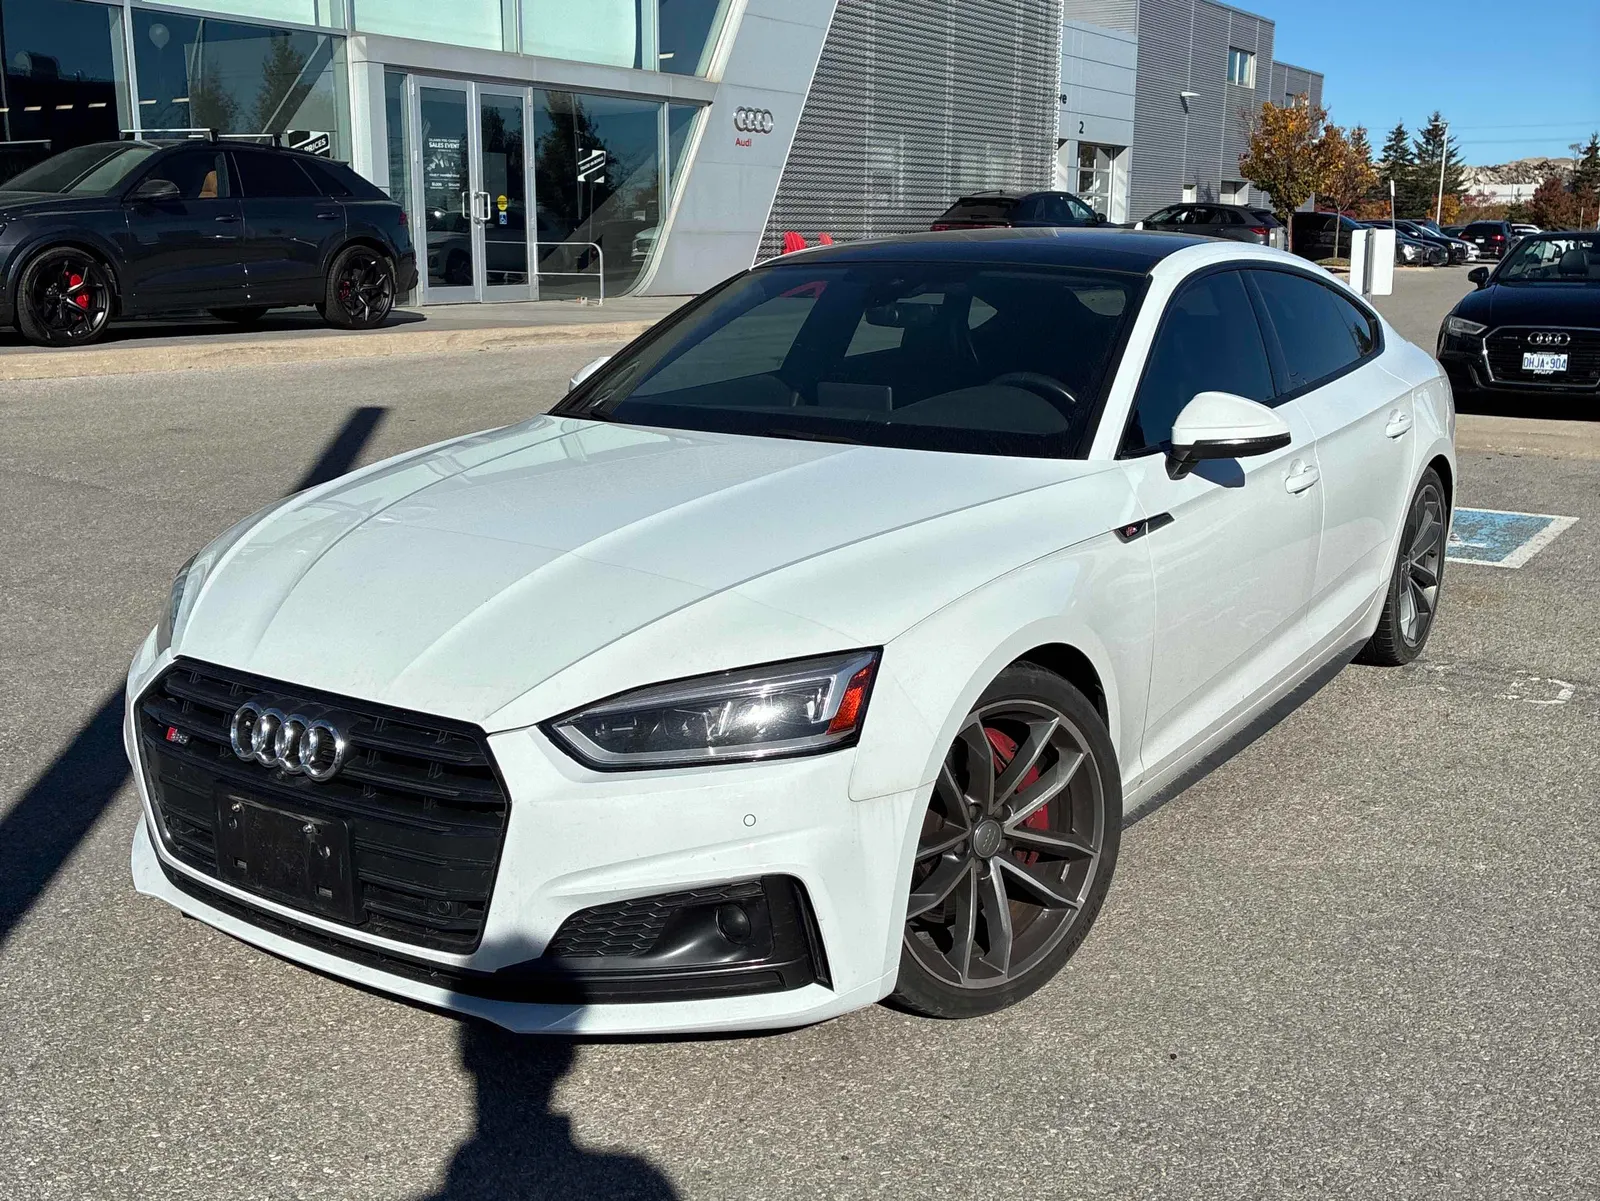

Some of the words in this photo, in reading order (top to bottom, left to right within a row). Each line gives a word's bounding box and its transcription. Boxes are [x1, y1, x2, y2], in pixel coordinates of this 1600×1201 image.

[1078, 120, 1084, 134] 2
[303, 138, 326, 152] PRICES
[735, 137, 752, 147] Audi
